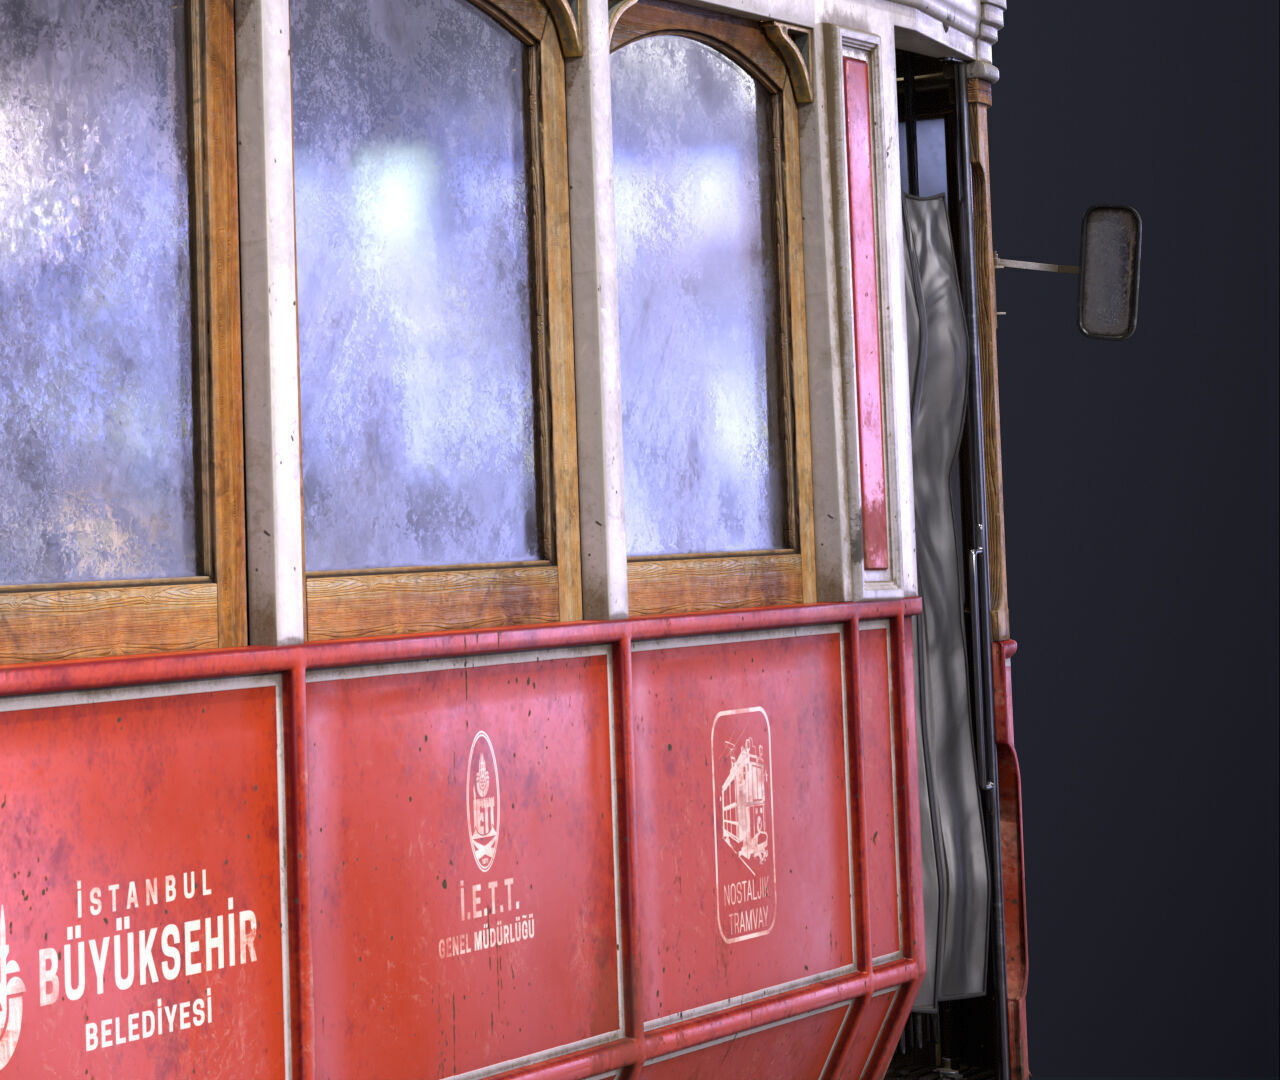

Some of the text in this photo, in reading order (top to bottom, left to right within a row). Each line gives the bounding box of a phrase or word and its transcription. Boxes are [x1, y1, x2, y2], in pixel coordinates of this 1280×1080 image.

[77, 869, 212, 918] İSTANBUL
[460, 877, 520, 921] İ.E.T.T.
[438, 913, 535, 959] GENEL MÜDÜRLÜĞÜ
[729, 905, 768, 935] TRAMVAY
[38, 897, 258, 1007] BÜYÜKSEHİR
[85, 988, 213, 1052] BELEDİYESİ
